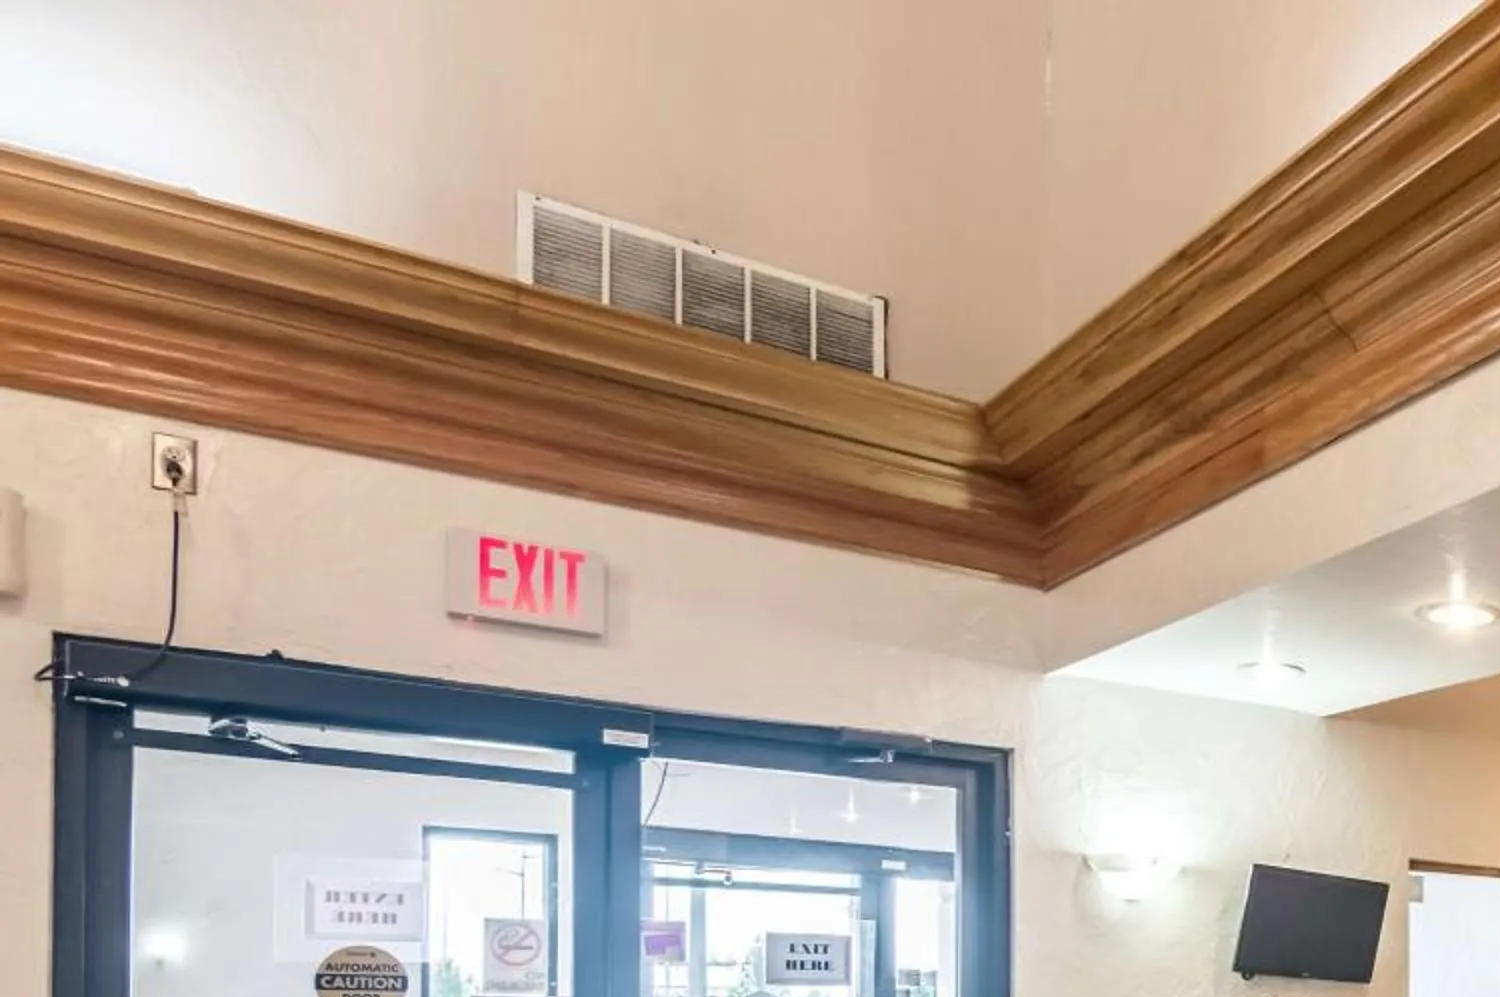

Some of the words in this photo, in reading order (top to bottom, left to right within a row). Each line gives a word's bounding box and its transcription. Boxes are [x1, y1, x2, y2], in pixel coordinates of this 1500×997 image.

[479, 537, 586, 618] EXIT
[789, 943, 832, 955] EXIT
[325, 963, 399, 973] AUTOMATIC
[785, 959, 835, 971] HERE
[321, 975, 403, 989] CAUTION
